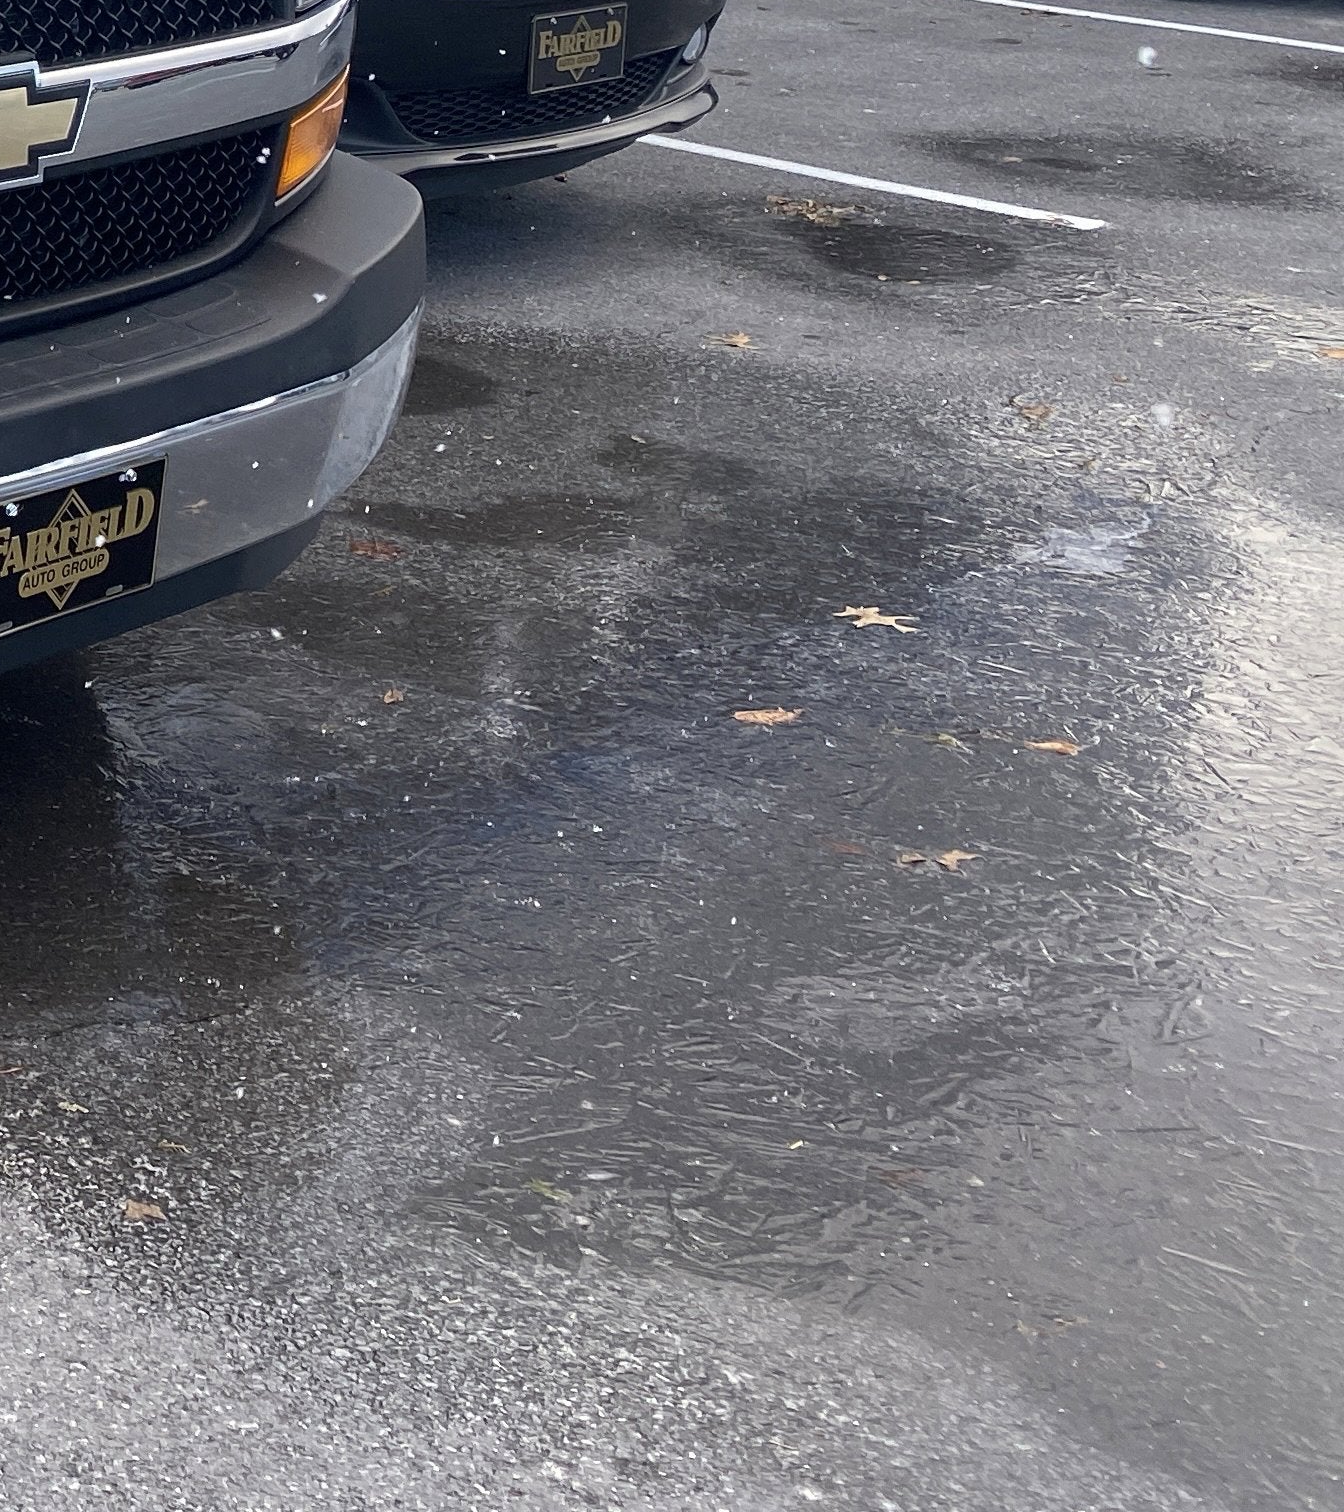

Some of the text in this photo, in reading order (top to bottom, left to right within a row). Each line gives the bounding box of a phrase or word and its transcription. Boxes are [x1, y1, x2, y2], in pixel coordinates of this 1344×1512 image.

[538, 20, 622, 59] FAIRFIELD
[22, 554, 106, 591] AUTO GROUP
